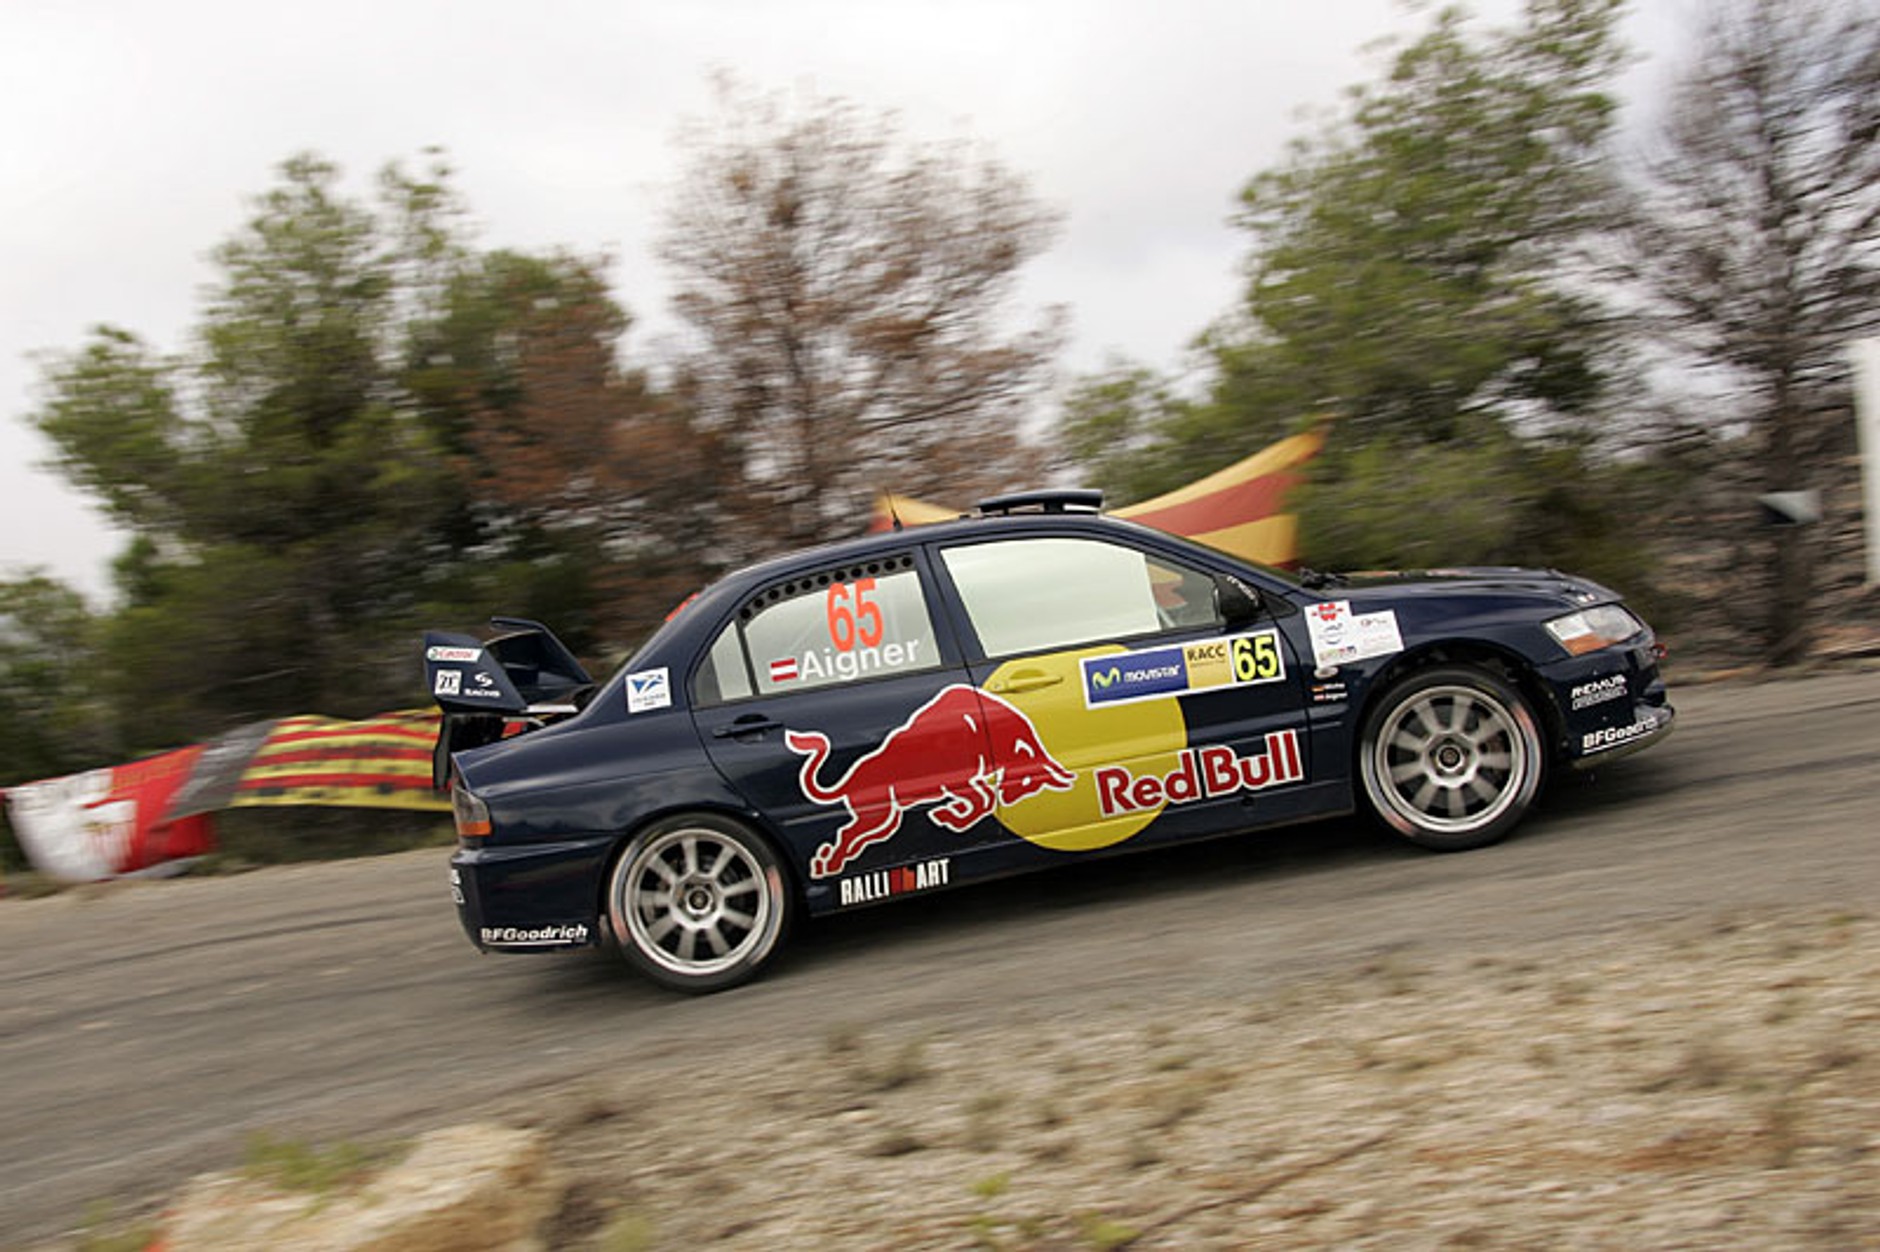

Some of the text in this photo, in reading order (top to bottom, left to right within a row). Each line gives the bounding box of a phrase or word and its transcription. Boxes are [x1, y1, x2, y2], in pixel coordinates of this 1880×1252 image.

[827, 577, 884, 653] 65
[801, 639, 919, 681] Aigner
[1187, 645, 1225, 661] RACC
[1233, 635, 1278, 681] 65
[1095, 729, 1304, 818] Red Bull
[481, 924, 588, 941] BFGoodrich
